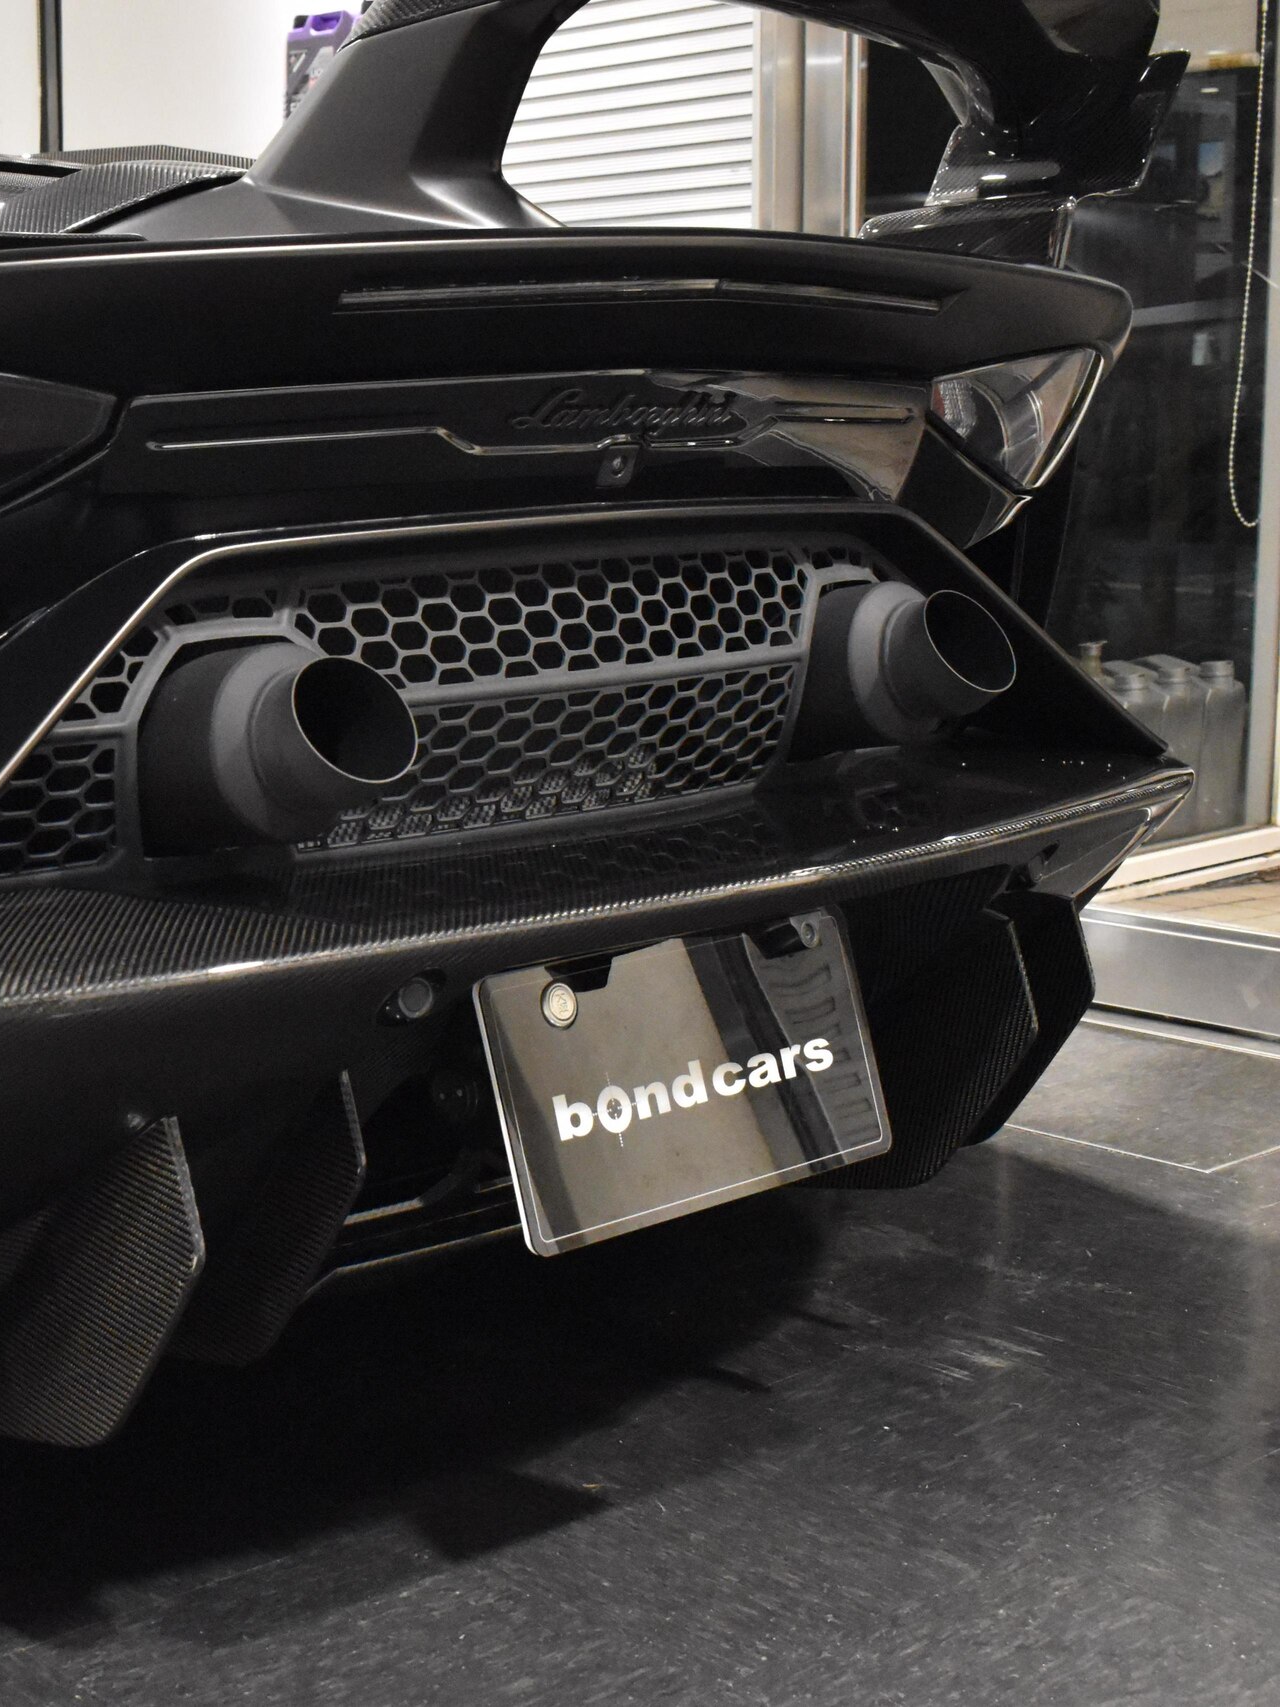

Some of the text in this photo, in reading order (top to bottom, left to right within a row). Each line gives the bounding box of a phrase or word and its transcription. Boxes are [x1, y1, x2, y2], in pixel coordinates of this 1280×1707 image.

[511, 388, 734, 436] Lamborghini
[552, 1037, 834, 1142] bond cars
